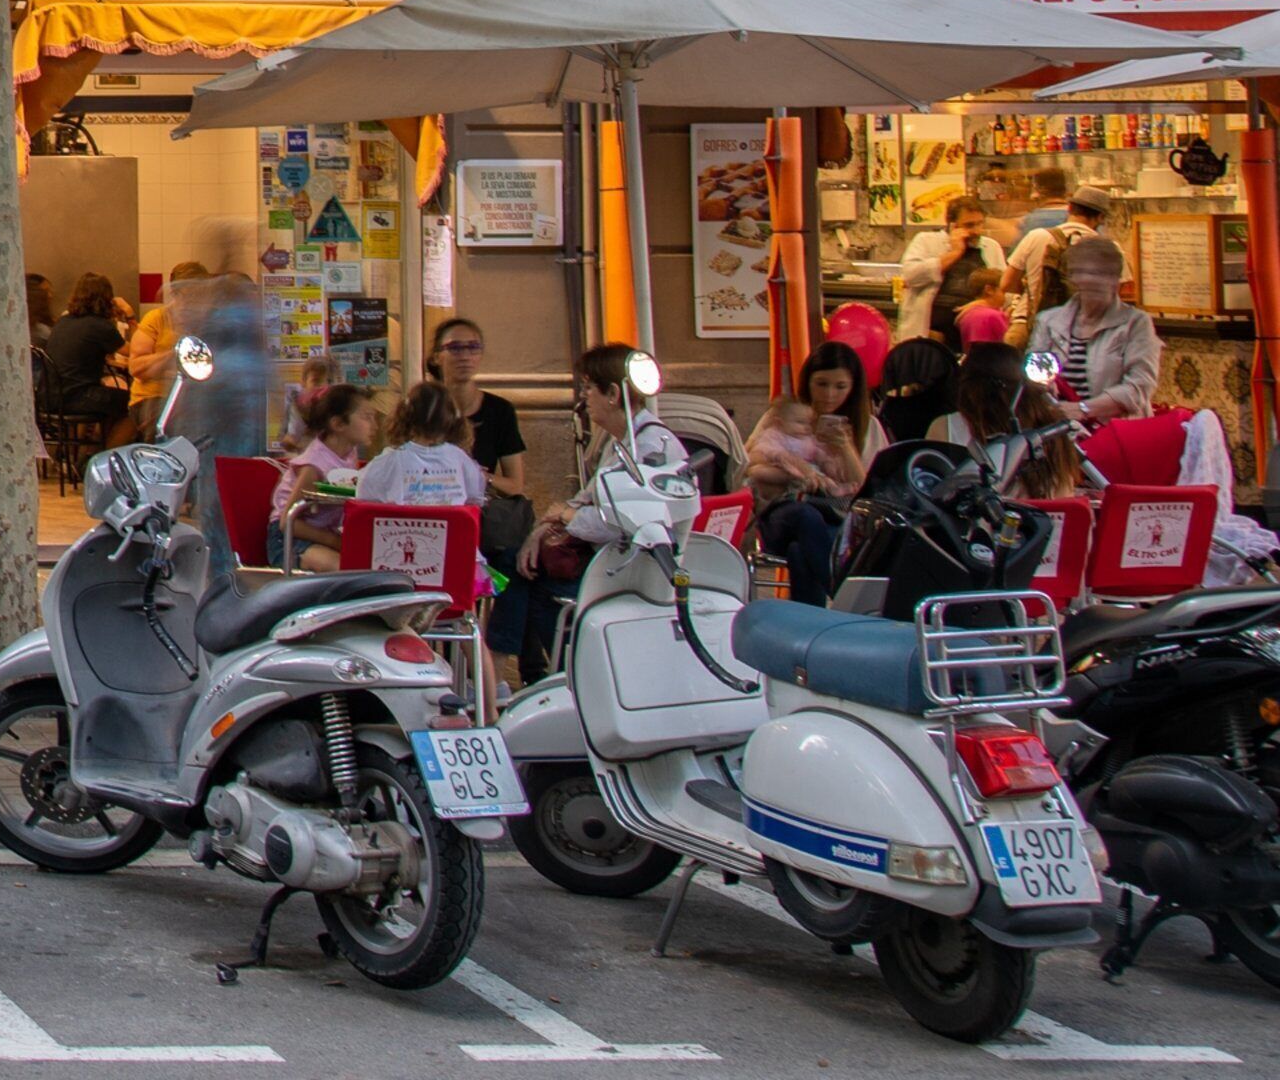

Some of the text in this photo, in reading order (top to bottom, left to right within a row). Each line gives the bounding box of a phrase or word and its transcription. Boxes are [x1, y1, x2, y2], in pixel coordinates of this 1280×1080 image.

[703, 139, 738, 152] GOFRES
[375, 520, 446, 530] ORXATERIA
[414, 565, 439, 576] CHE
[437, 736, 502, 768] 5681
[426, 760, 436, 772] E
[449, 769, 500, 800] GLS
[1011, 827, 1075, 861] 4907
[996, 856, 1009, 869] E
[1019, 862, 1078, 899] GXC
